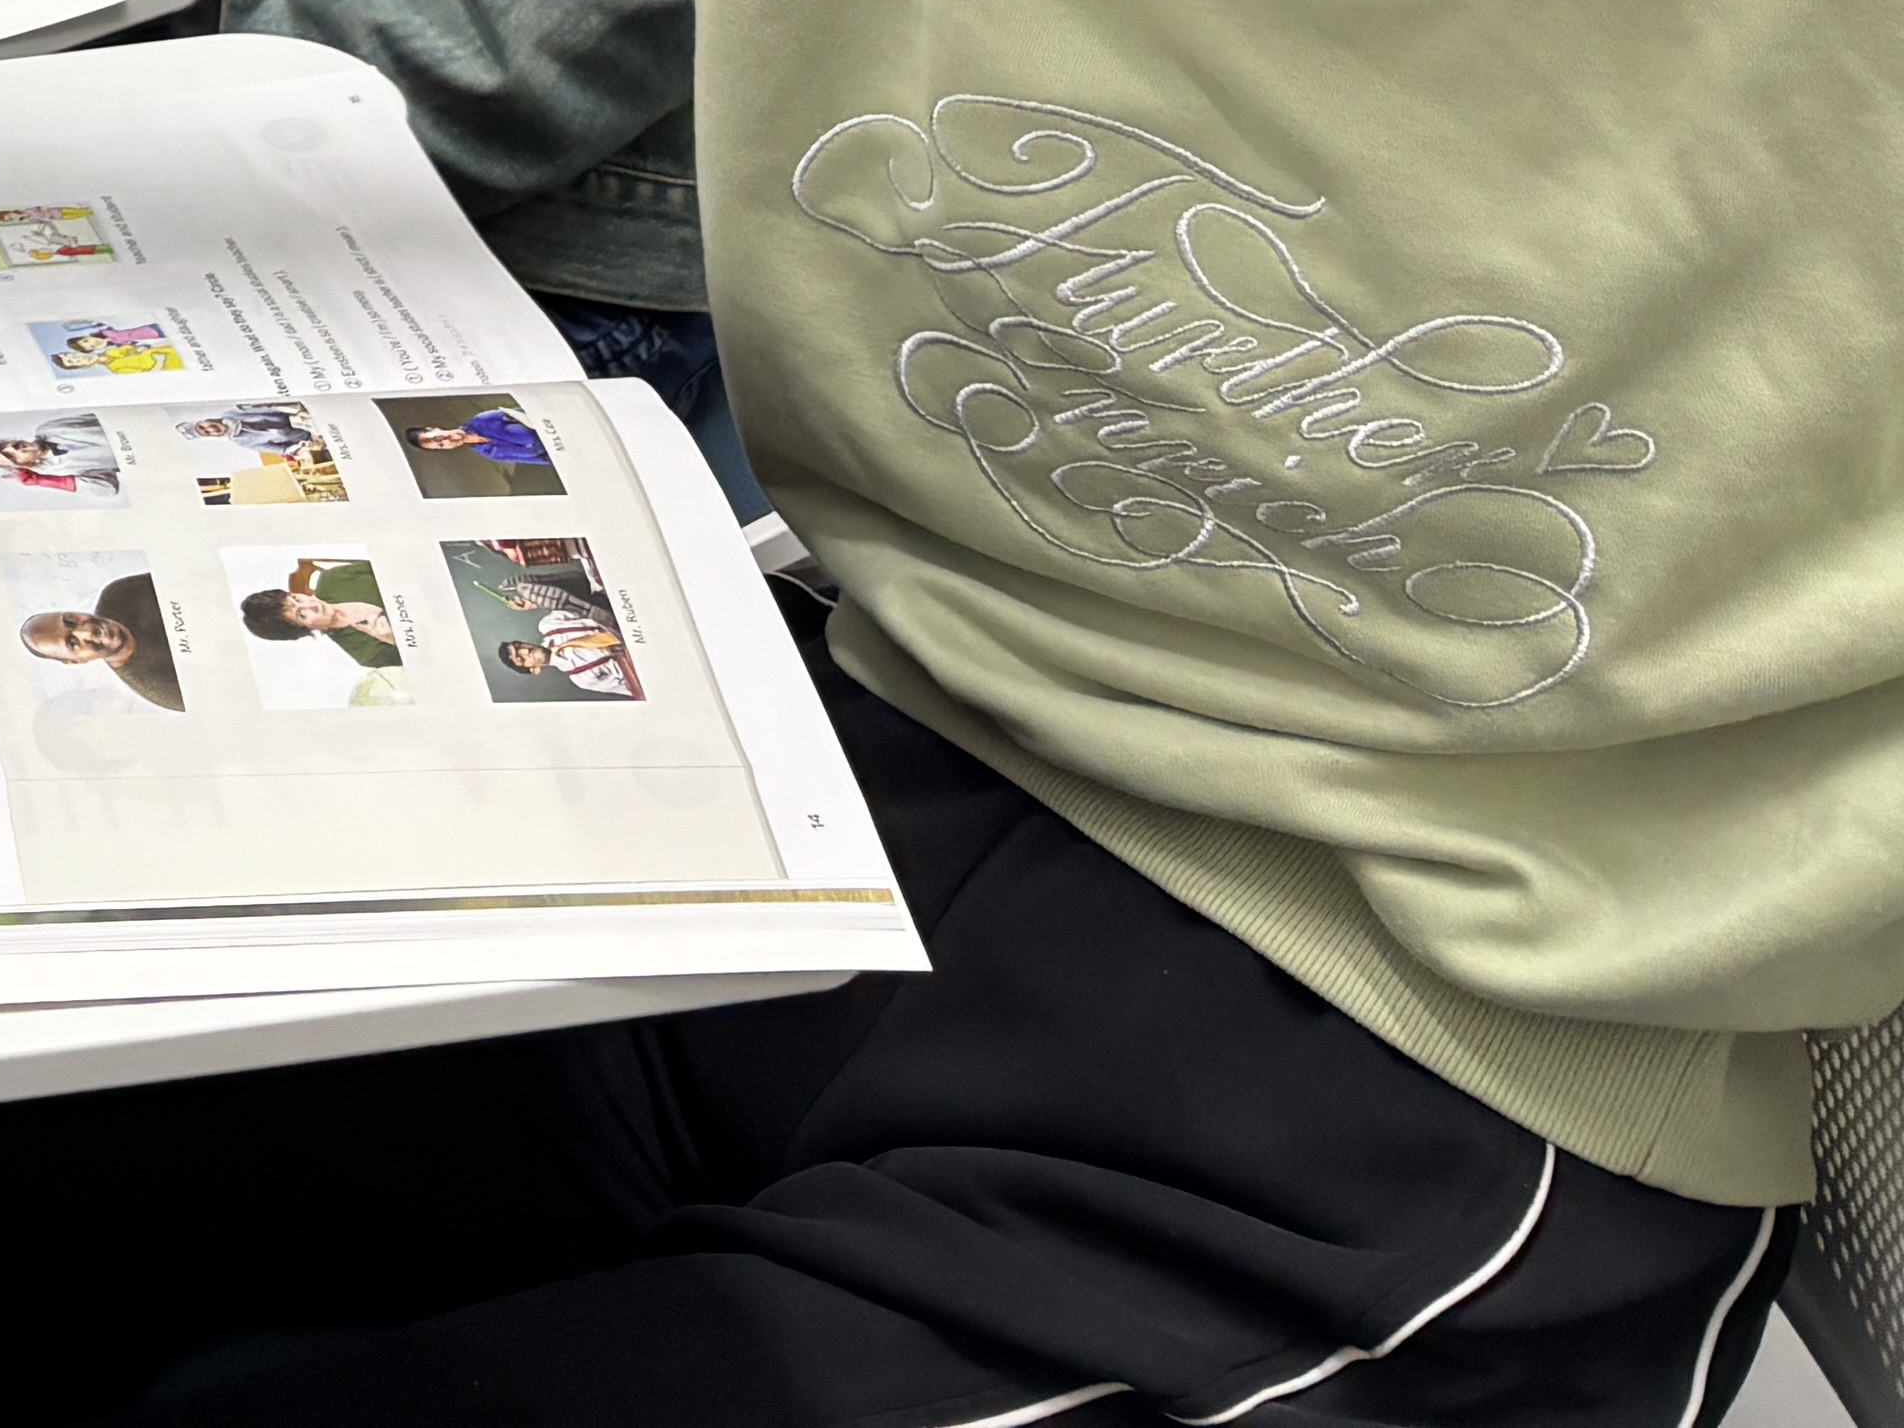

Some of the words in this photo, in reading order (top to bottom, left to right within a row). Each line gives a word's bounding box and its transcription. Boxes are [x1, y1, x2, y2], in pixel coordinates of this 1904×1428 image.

[310, 366, 326, 380] My
[394, 594, 414, 623] Jones
[617, 589, 638, 623] Ruben
